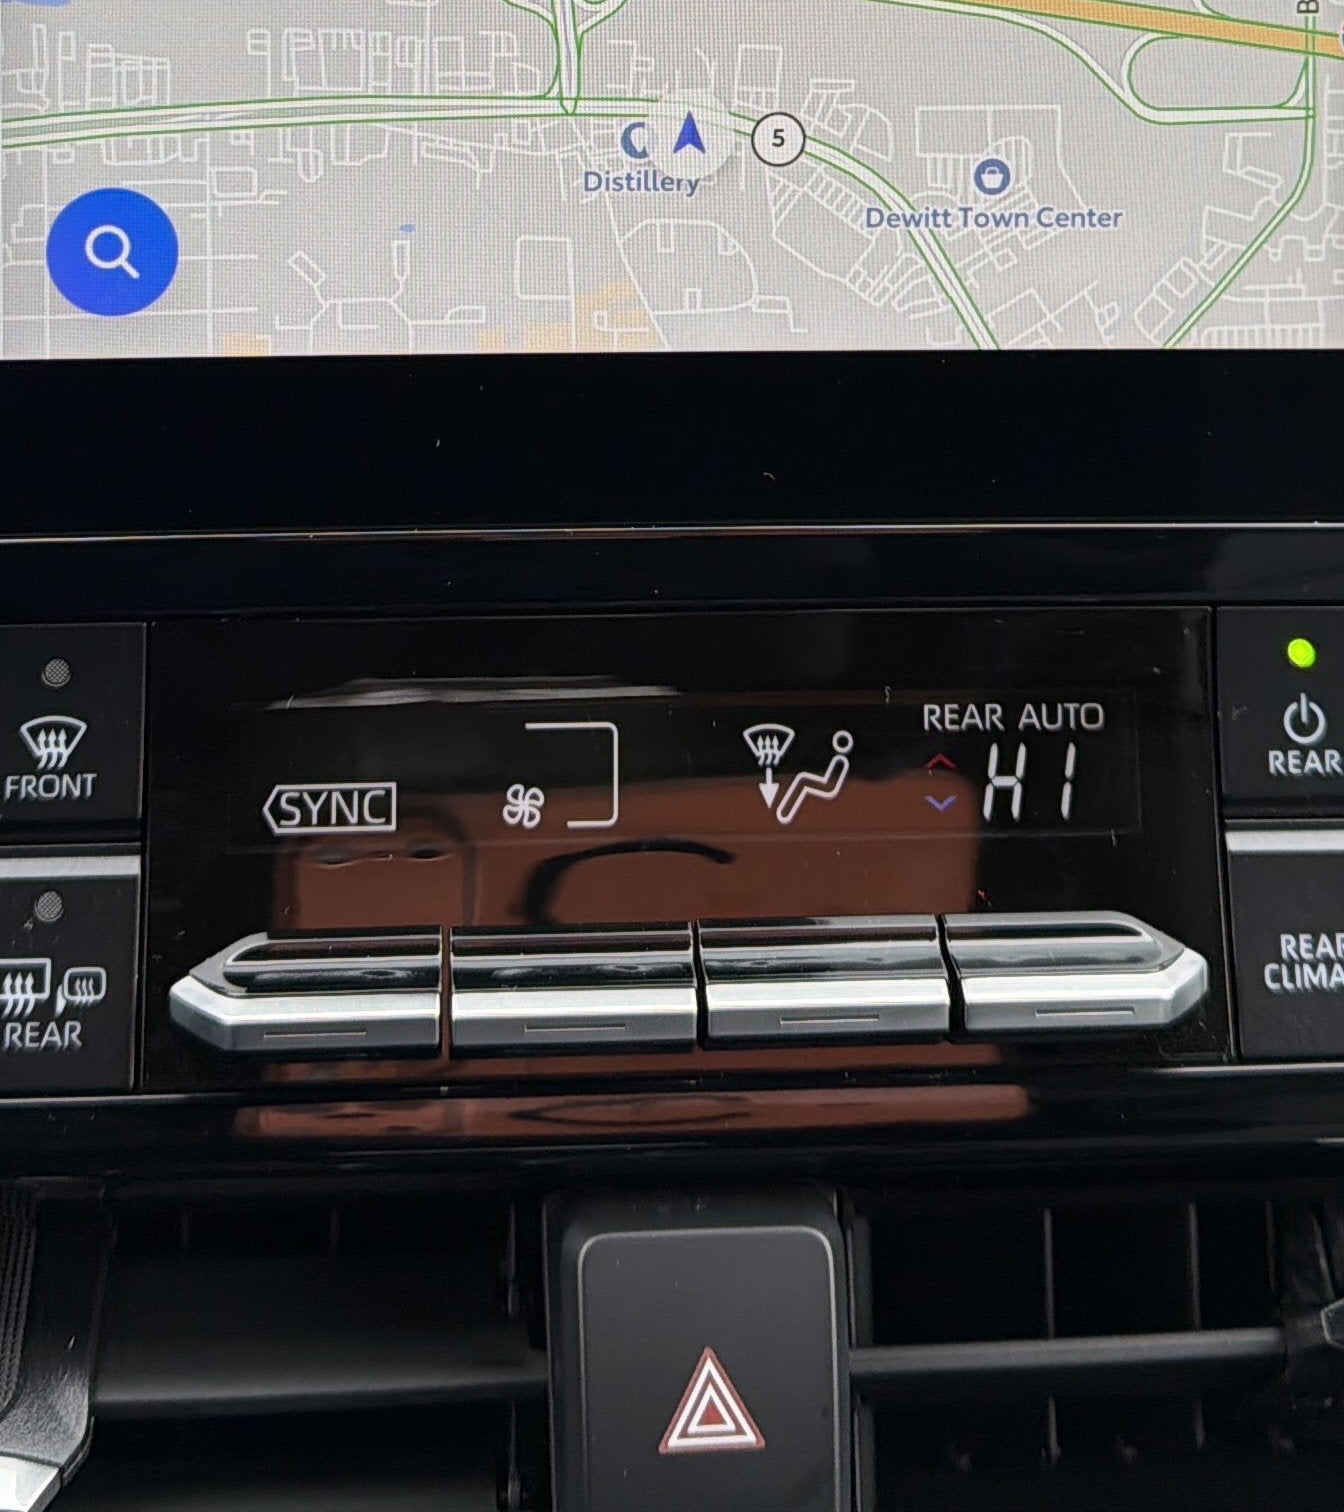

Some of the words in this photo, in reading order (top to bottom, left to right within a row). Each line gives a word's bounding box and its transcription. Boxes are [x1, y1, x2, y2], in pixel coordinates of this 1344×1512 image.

[771, 129, 786, 148] 5
[583, 170, 701, 196] Distillery
[865, 207, 953, 230] Dewitt
[959, 207, 1030, 230] Town
[1035, 207, 1124, 230] Center
[922, 702, 1005, 732] REAR
[1017, 702, 1105, 731] AUTO
[1267, 749, 1344, 776] REAR
[3, 772, 97, 800] FRONT
[277, 789, 387, 826] SYNC
[2, 1020, 84, 1050] REAR
